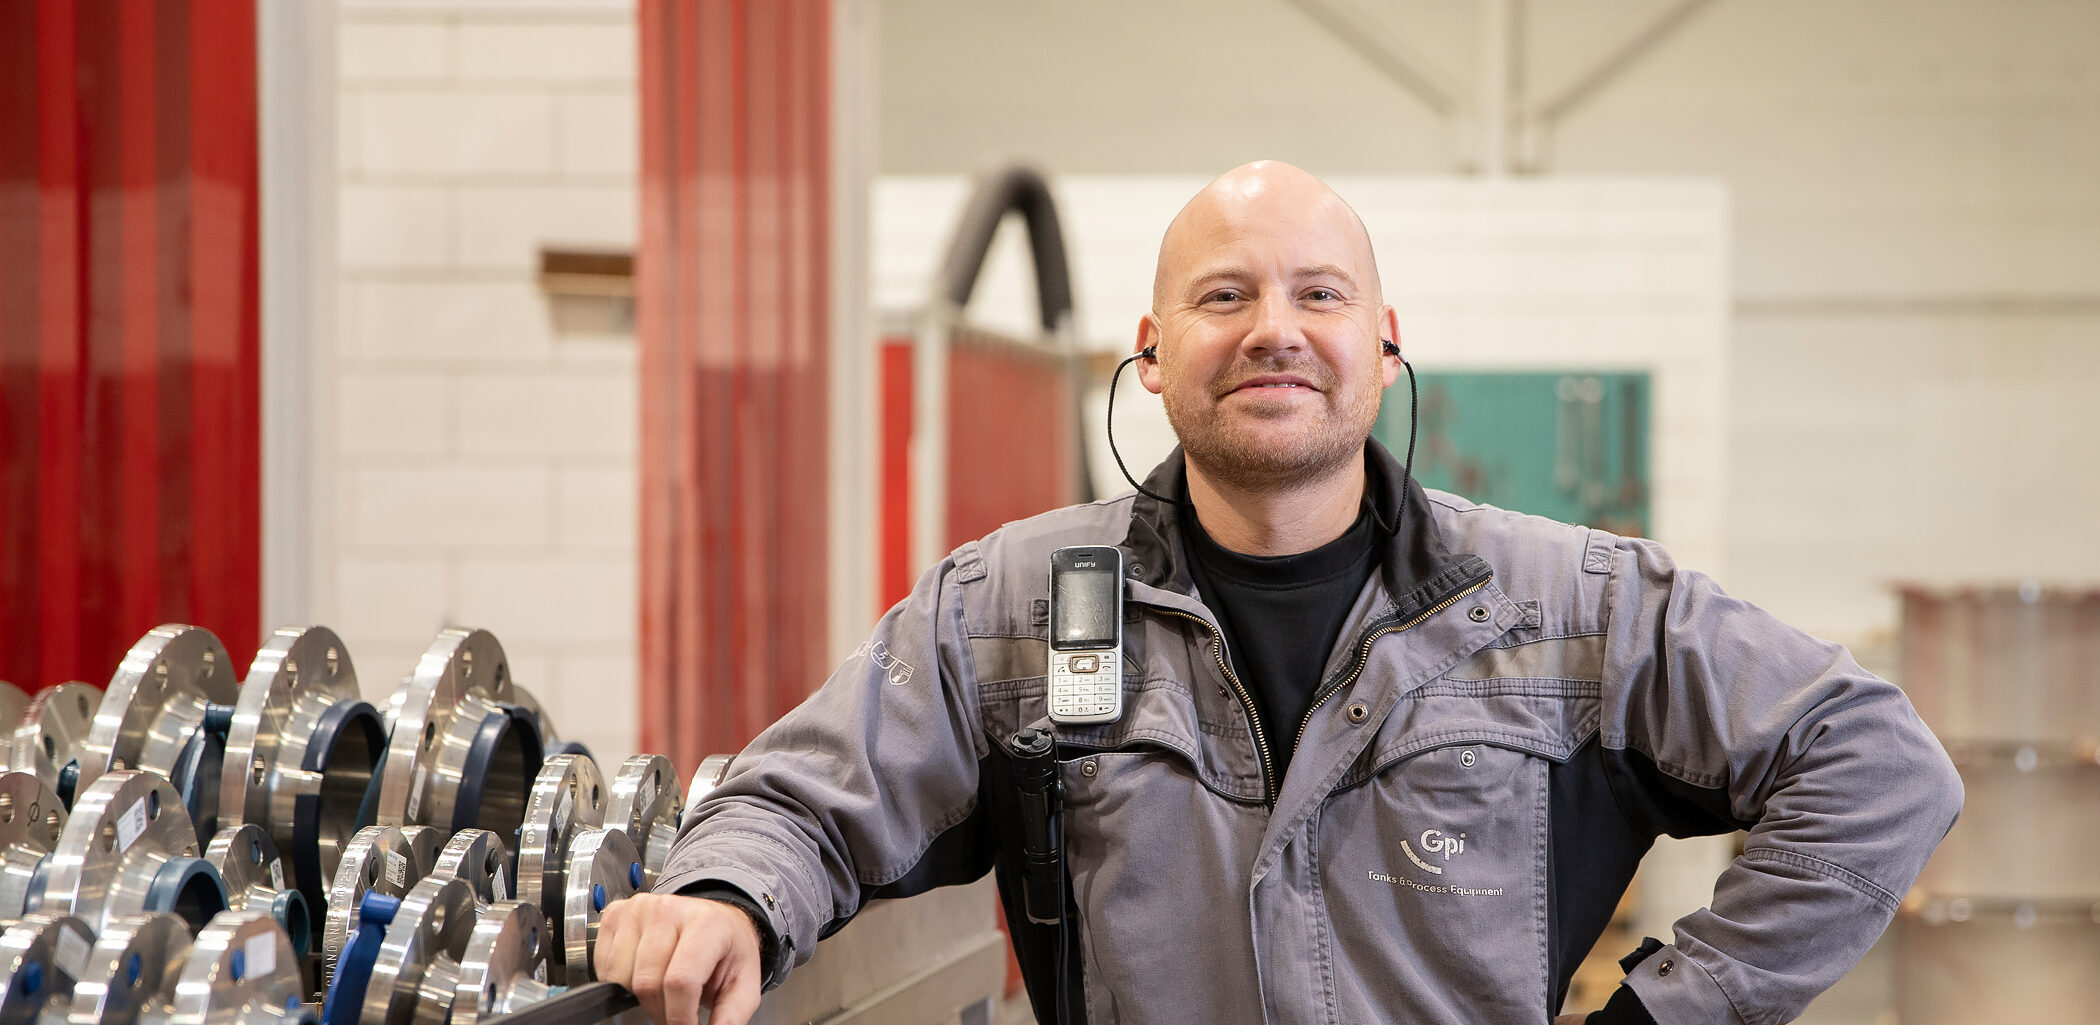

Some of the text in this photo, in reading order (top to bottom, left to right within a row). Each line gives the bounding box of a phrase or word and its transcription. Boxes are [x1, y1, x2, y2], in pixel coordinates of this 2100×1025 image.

[1420, 829, 1466, 860] Gpi
[1368, 871, 1397, 884] Tanks
[1407, 880, 1448, 894] Process
